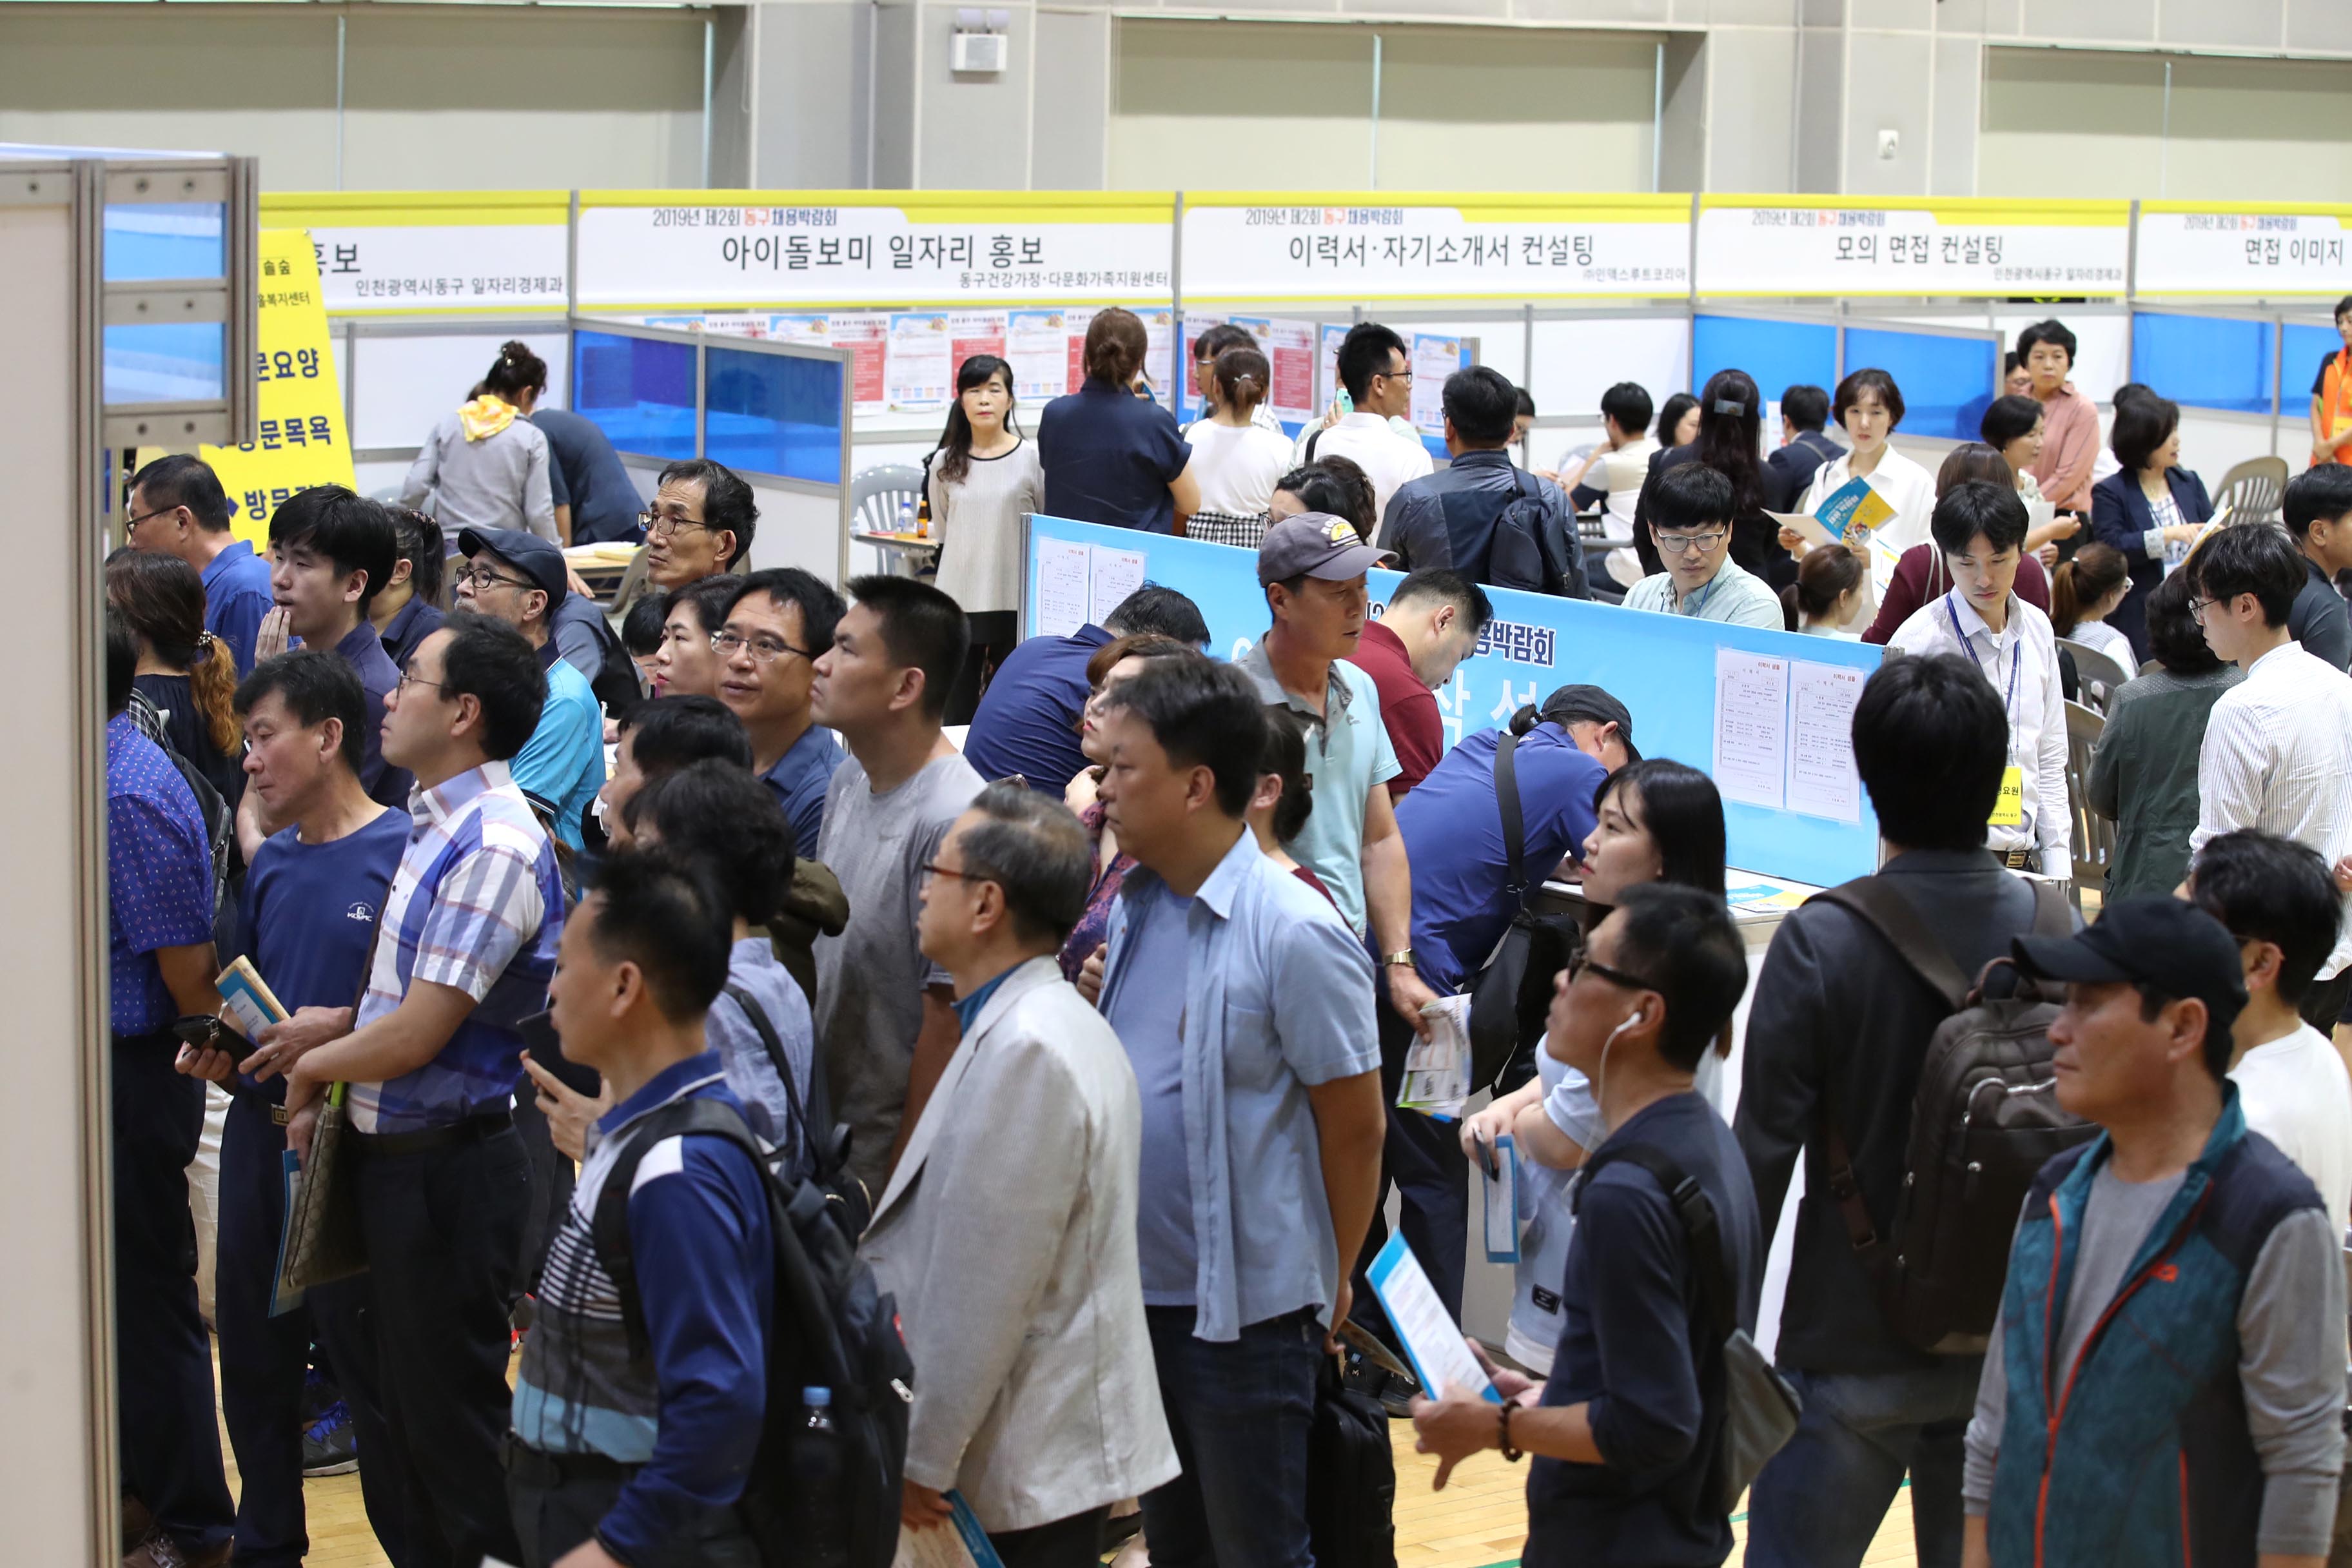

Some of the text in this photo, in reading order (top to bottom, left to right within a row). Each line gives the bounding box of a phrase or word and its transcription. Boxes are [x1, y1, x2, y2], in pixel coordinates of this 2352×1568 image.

[652, 207, 836, 226] 2019년 제2회 동구 채용박람회
[1244, 206, 1403, 224] 2019년 제2회 동구 채용박람회
[723, 234, 1044, 271] 아이돌보미 일자리 홍보
[1289, 235, 1593, 268] 이력서·자기소개서 컨설팅
[1835, 235, 2003, 264] 모의 면접 컨설팅
[2246, 238, 2343, 266] 면접 이미지
[355, 277, 562, 297] 인천광역시동구 일자리경제과
[959, 271, 1167, 288] 동구건강가정·다문화가족지원센터
